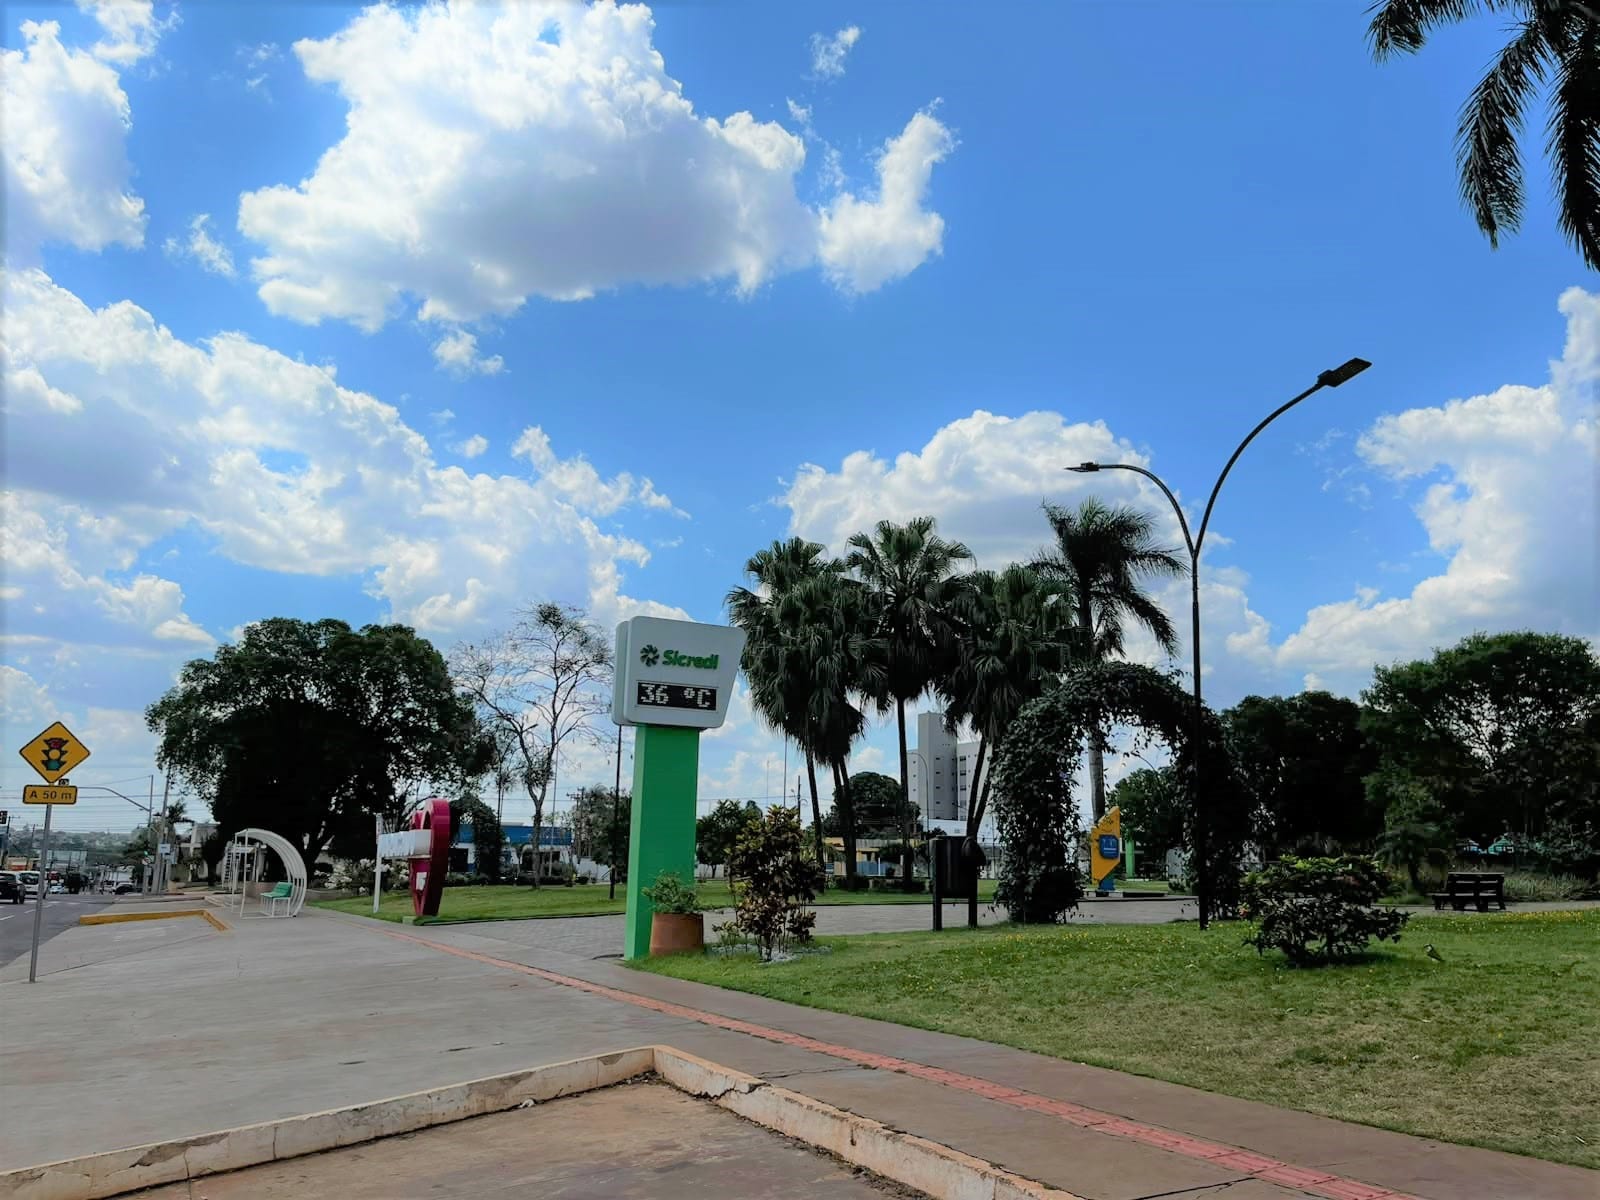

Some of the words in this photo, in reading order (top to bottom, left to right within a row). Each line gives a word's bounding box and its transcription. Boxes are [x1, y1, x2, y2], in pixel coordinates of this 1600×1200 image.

[662, 649, 719, 670] Sicredi
[641, 683, 669, 704] 36
[29, 790, 38, 800] A
[43, 790, 57, 800] 50
[61, 792, 72, 800] m
